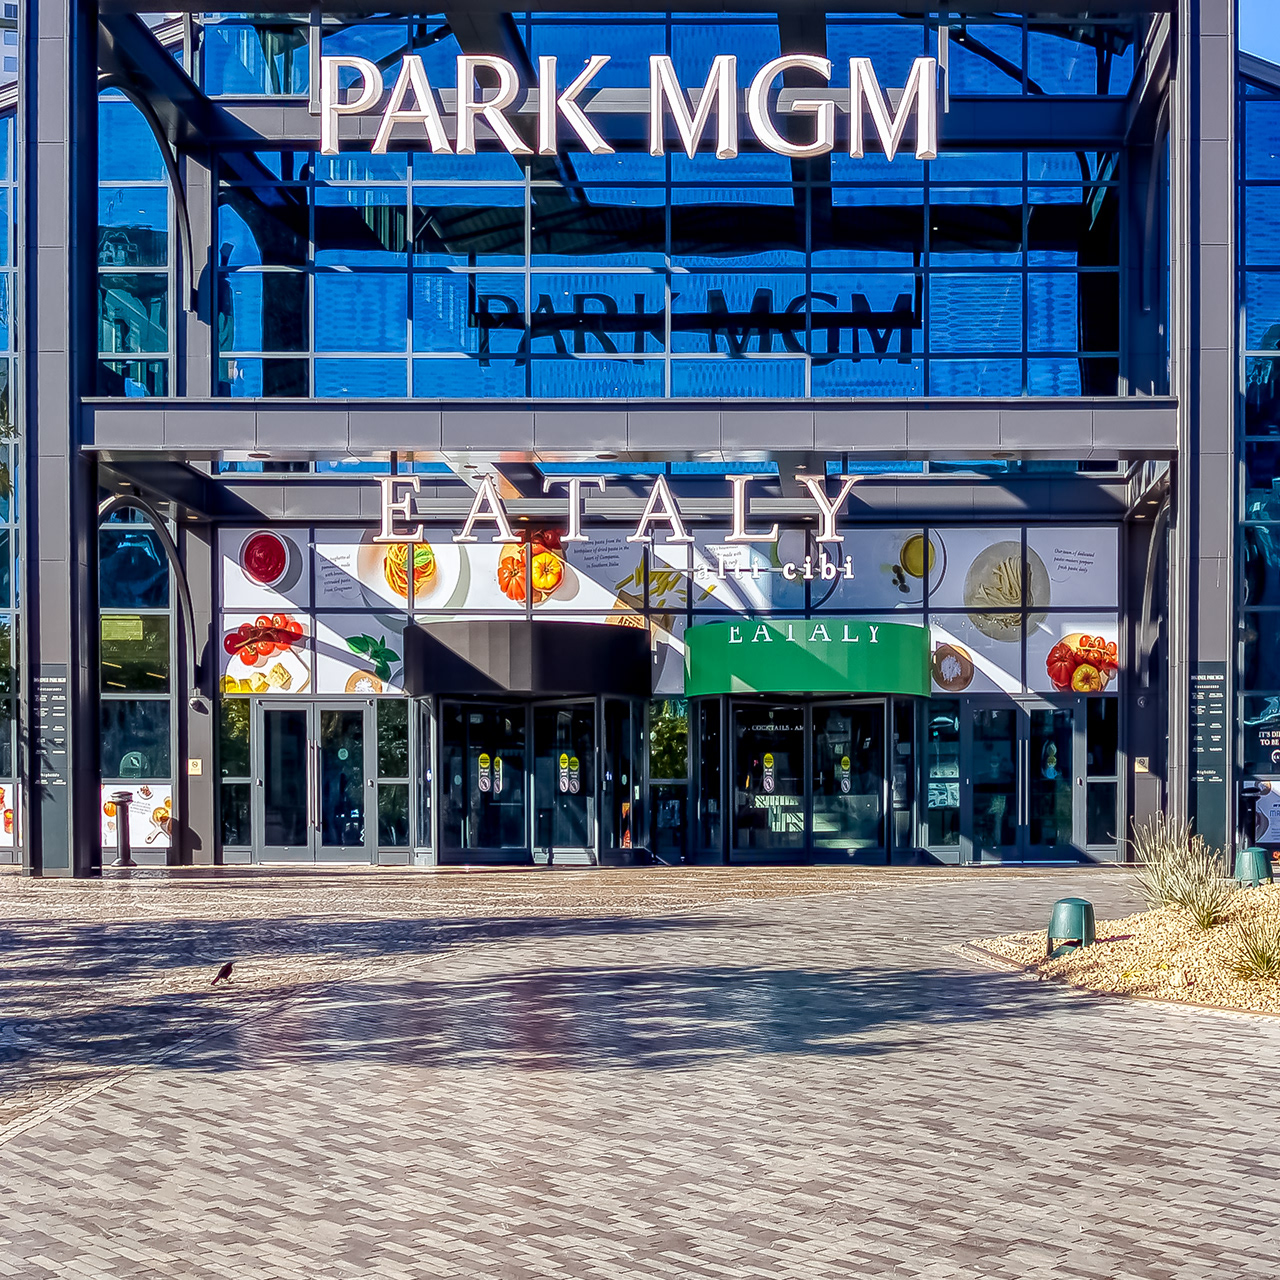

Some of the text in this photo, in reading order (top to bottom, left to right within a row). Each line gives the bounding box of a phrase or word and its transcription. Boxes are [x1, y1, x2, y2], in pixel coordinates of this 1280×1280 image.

[319, 52, 939, 162] PARK MGM
[371, 472, 862, 544] EATALY
[782, 553, 855, 580] cibi
